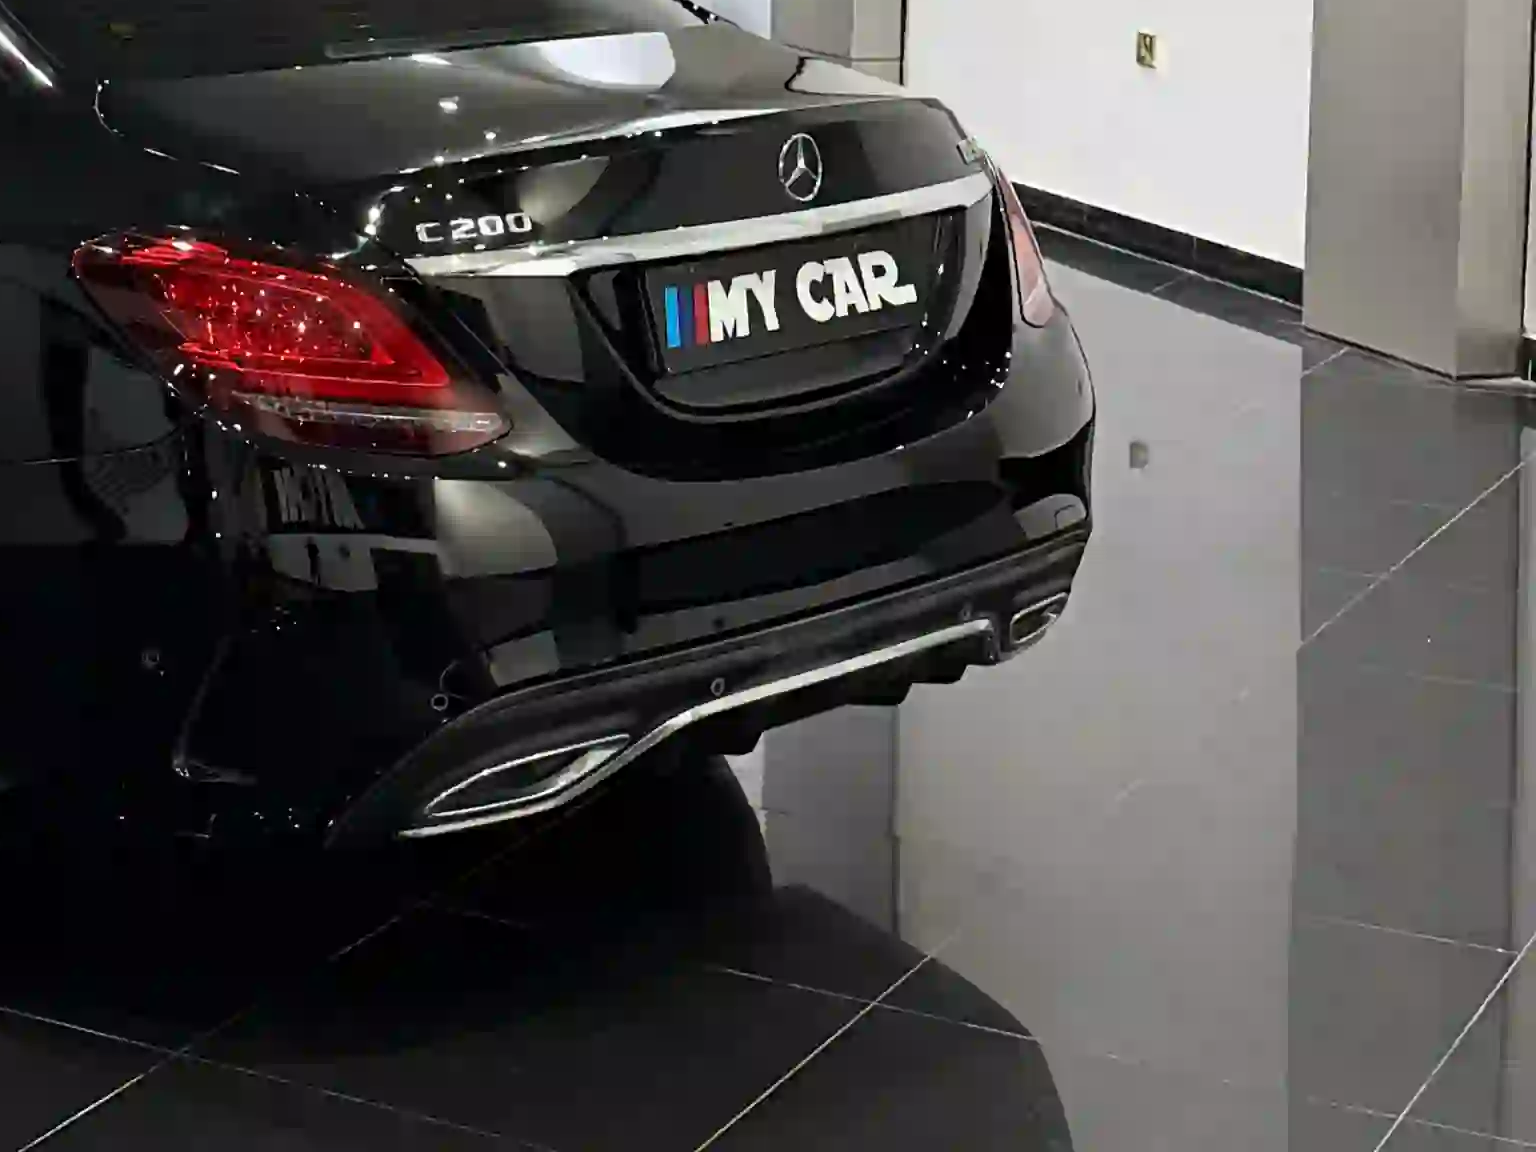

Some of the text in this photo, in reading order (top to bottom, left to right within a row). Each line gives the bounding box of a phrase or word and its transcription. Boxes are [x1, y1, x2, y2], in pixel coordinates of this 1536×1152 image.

[415, 211, 534, 243] C 200
[707, 249, 918, 343] MY CAR
